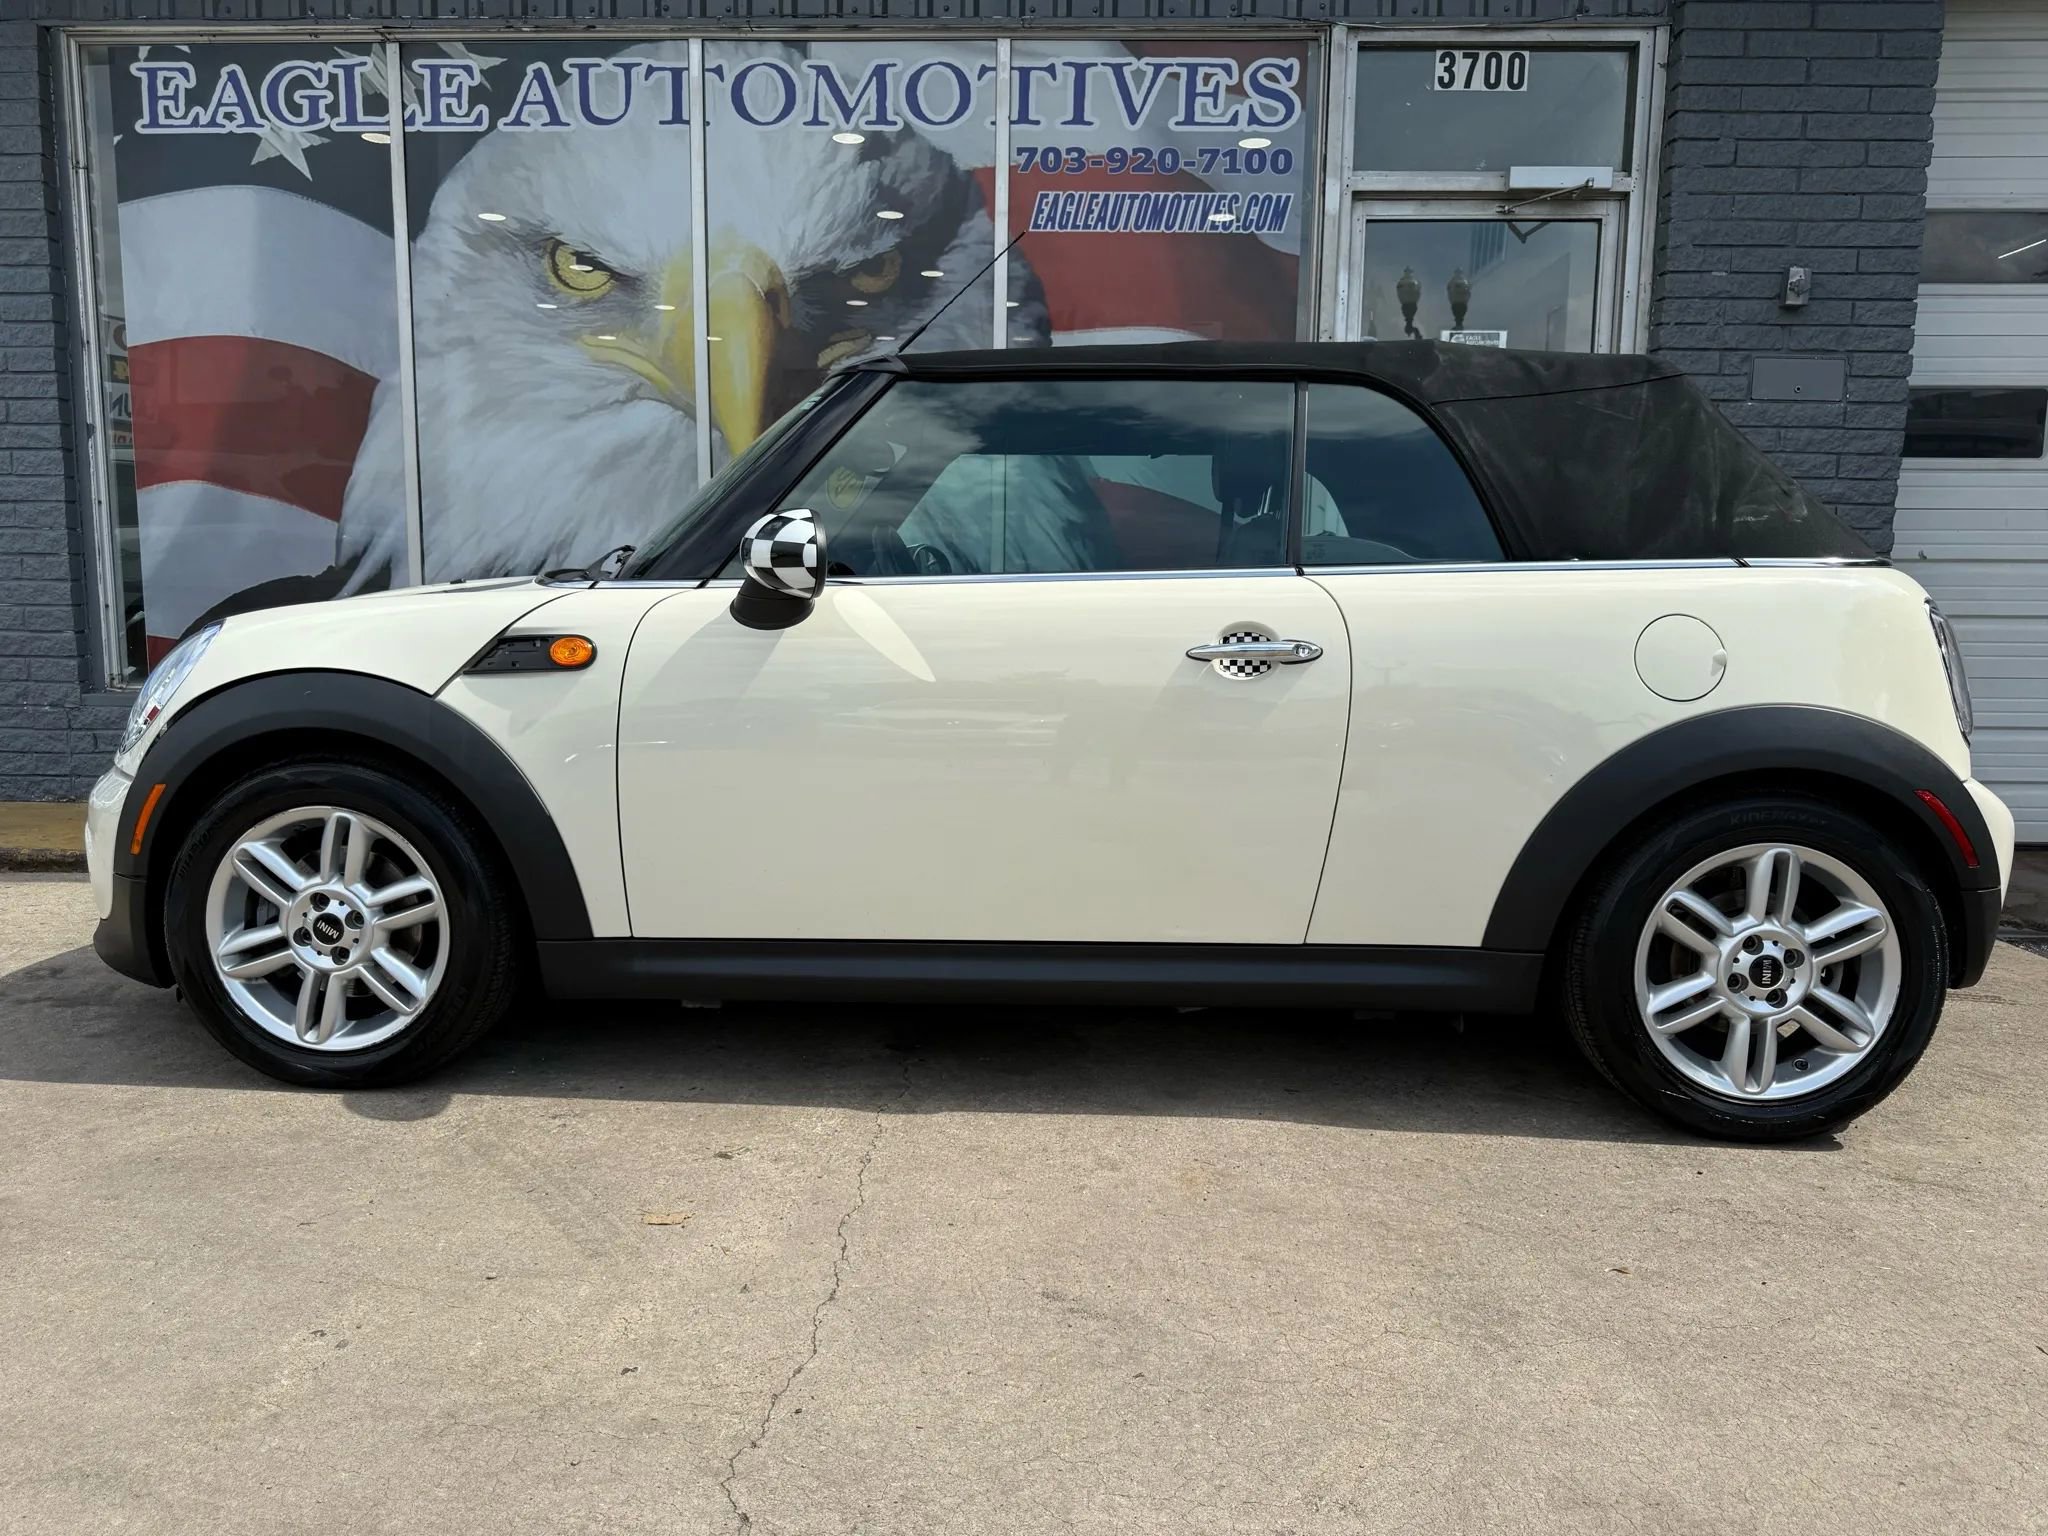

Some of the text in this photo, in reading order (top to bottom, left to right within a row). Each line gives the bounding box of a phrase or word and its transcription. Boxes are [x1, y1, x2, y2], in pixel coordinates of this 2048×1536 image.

[1437, 51, 1526, 90] 3700
[130, 56, 1302, 133] EAGLE AUTOMOTIVES
[1015, 145, 1294, 176] 703-920-7100
[1030, 191, 1295, 234] EAGLEAUTOMOTIVES.COM
[316, 919, 340, 940] MINI
[1761, 959, 1772, 984] MINI
